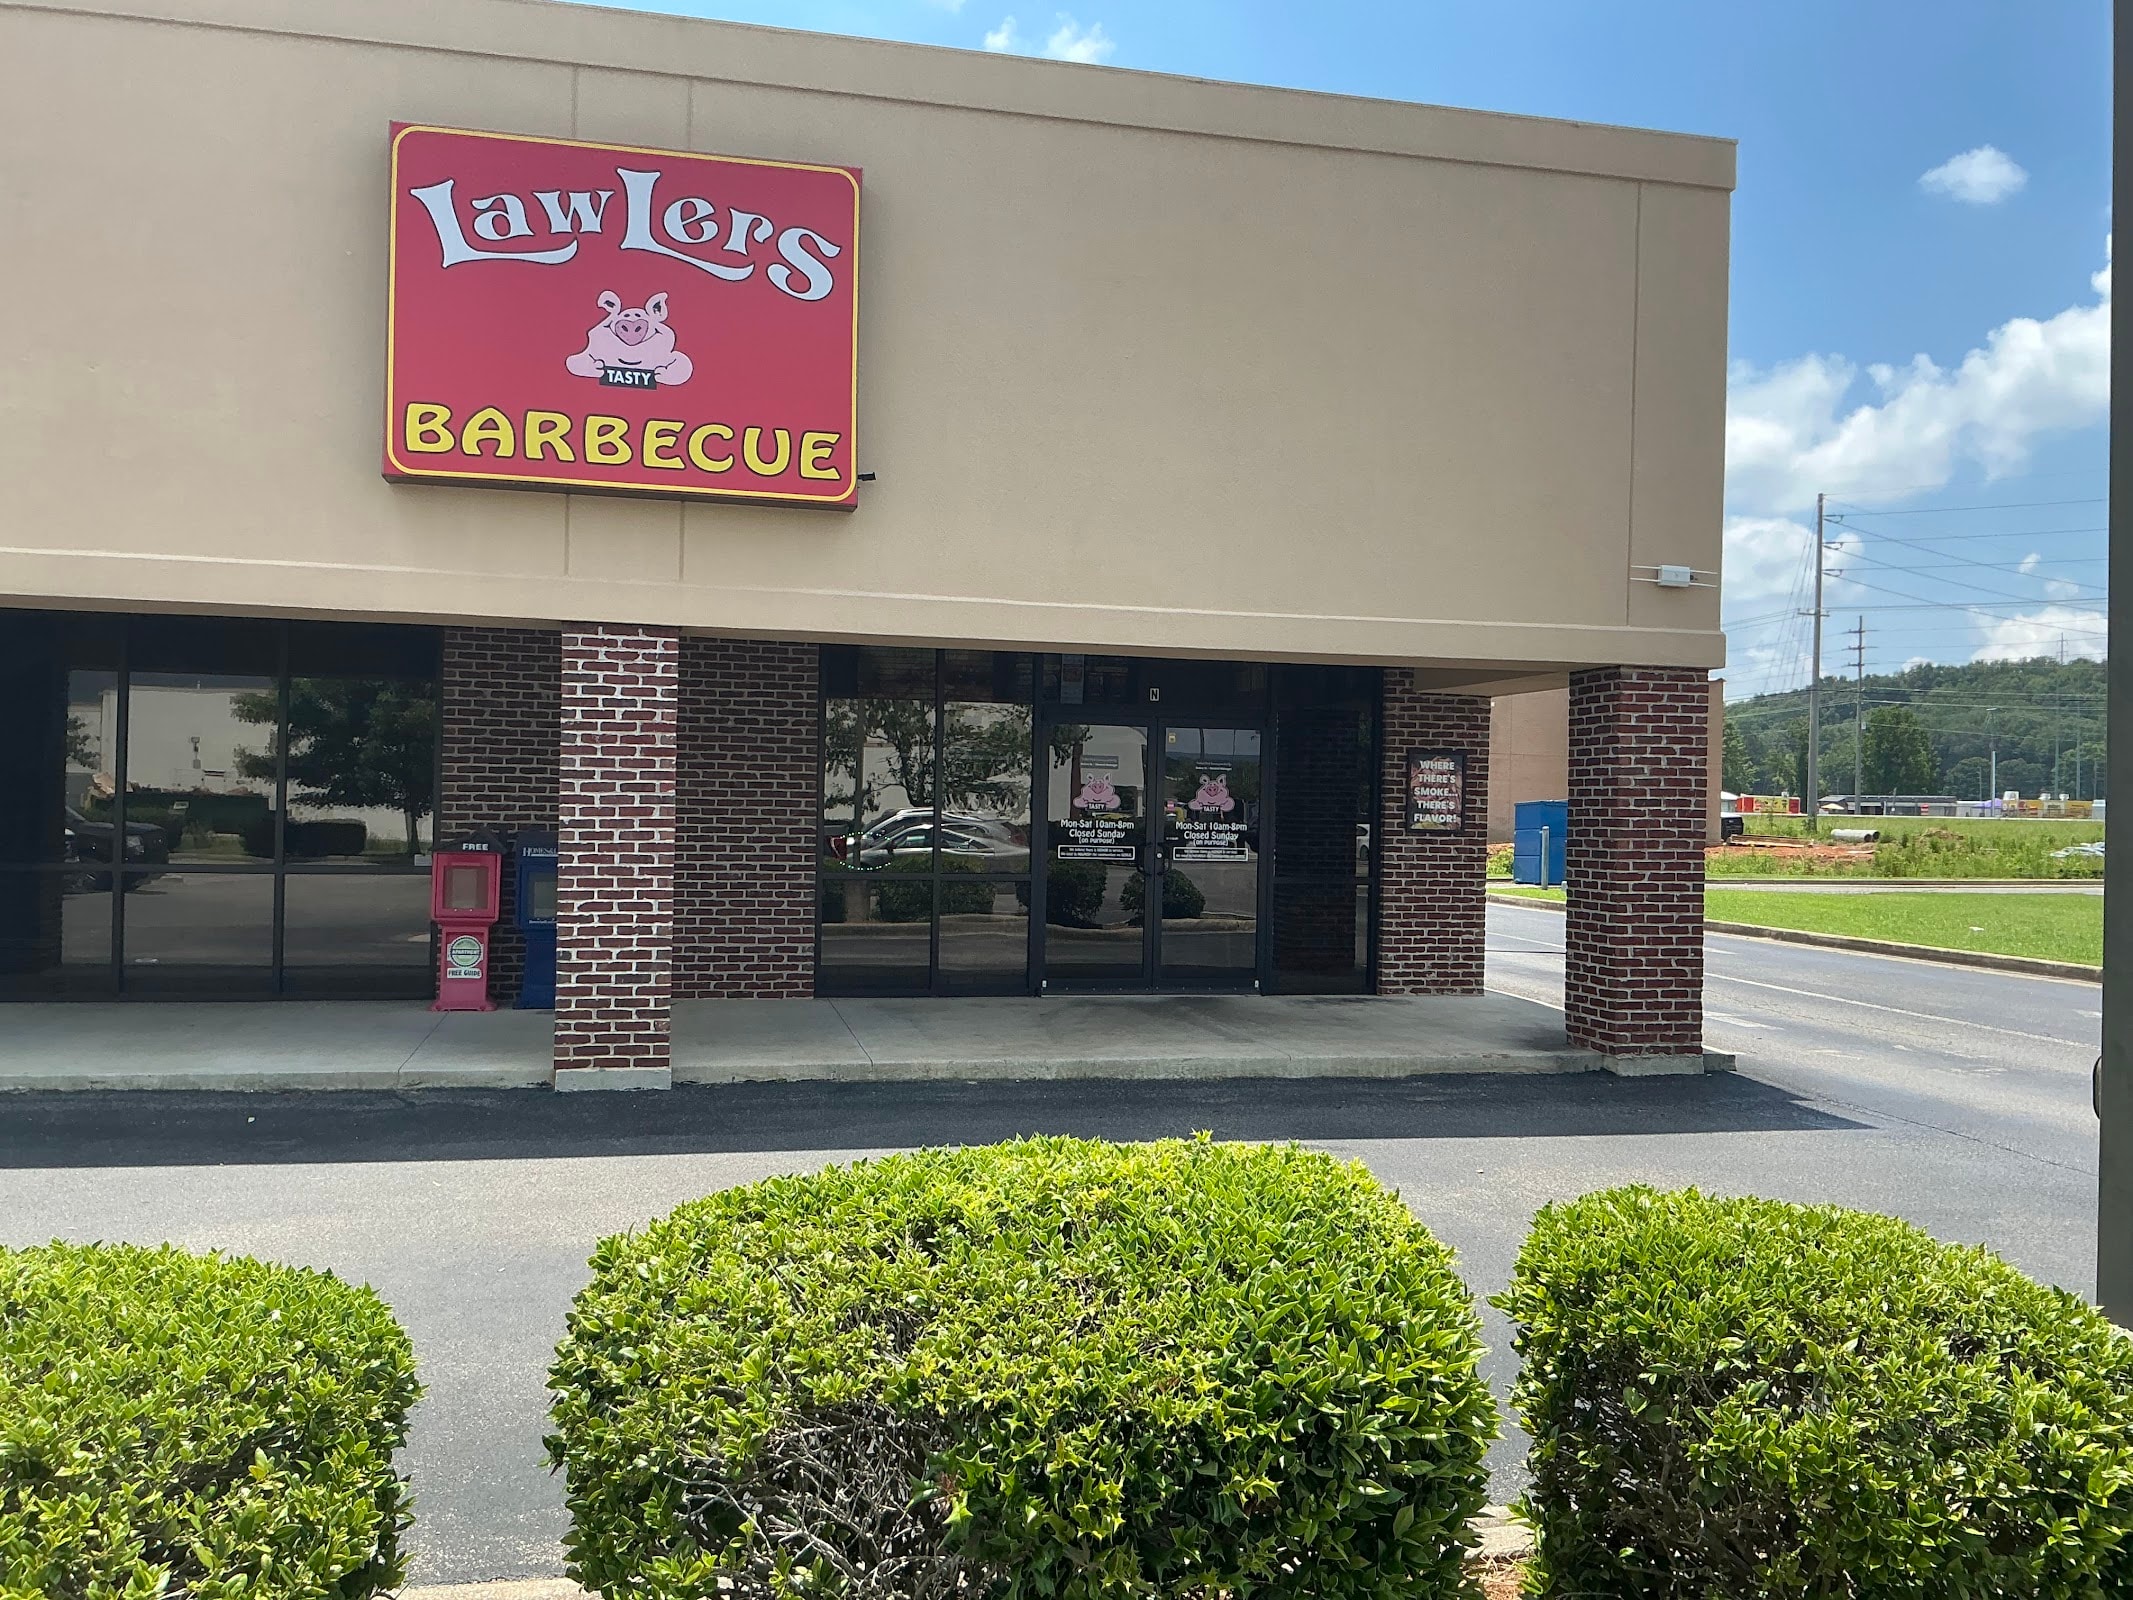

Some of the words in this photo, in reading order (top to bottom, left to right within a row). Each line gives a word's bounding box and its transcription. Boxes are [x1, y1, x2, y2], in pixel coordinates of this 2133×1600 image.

[606, 369, 652, 387] TASTY
[405, 402, 842, 481] BARBECUE
[1151, 689, 1158, 700] N
[1420, 760, 1455, 770] WHERE
[1418, 774, 1456, 784] THERE'S
[1414, 787, 1458, 797] SMOKE...
[1417, 800, 1455, 810] THERE'S
[1414, 813, 1457, 823] FLAVOR!
[1060, 819, 1093, 829] Mon-Sat
[1095, 820, 1134, 830] 10am-8pm
[1175, 822, 1207, 831] Mon-Sat
[1210, 822, 1248, 832] 10am-8pm
[1069, 828, 1096, 838] Closed
[1096, 828, 1126, 839] Sunday
[1184, 830, 1210, 840] Closed
[1210, 831, 1238, 840] Sunday
